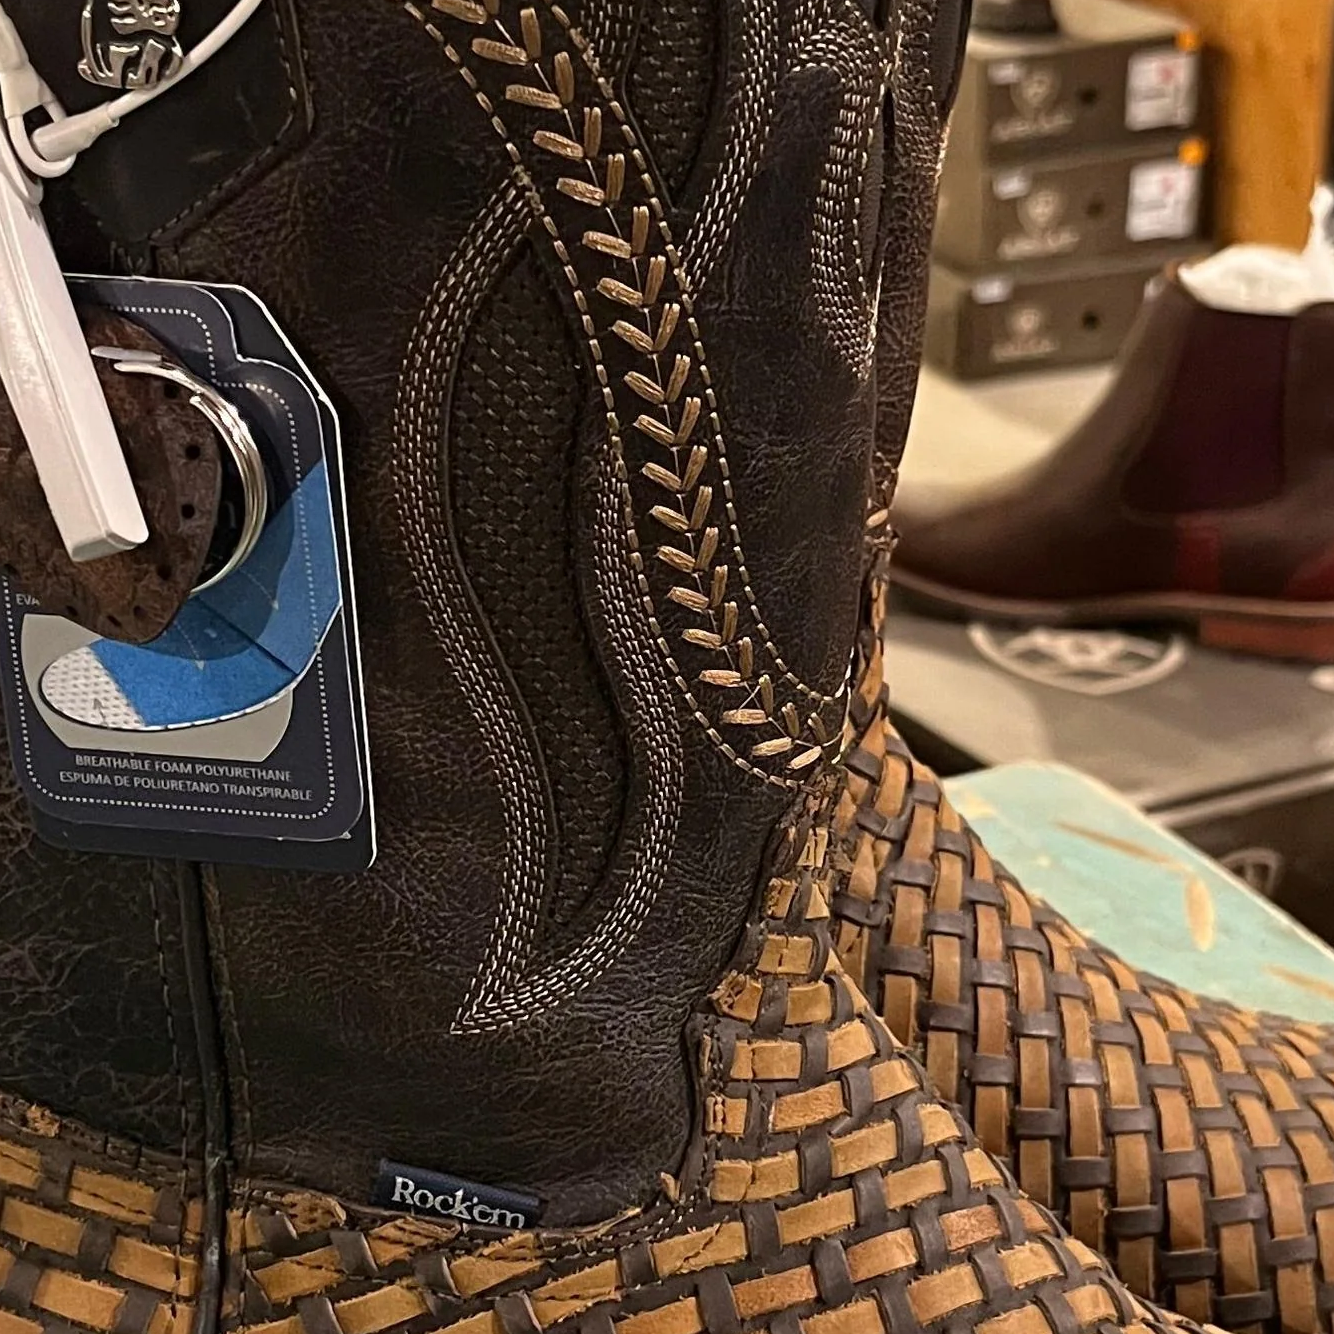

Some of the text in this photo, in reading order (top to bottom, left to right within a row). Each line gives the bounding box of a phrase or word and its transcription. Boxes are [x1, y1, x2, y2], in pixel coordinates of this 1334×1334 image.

[75, 754, 292, 783] BREATHABLE FOAM POLYURETHANE
[59, 771, 313, 801] ESPUMA DE POLIURETANO TRANSPIRABLE
[391, 1175, 525, 1229] Rock'em
